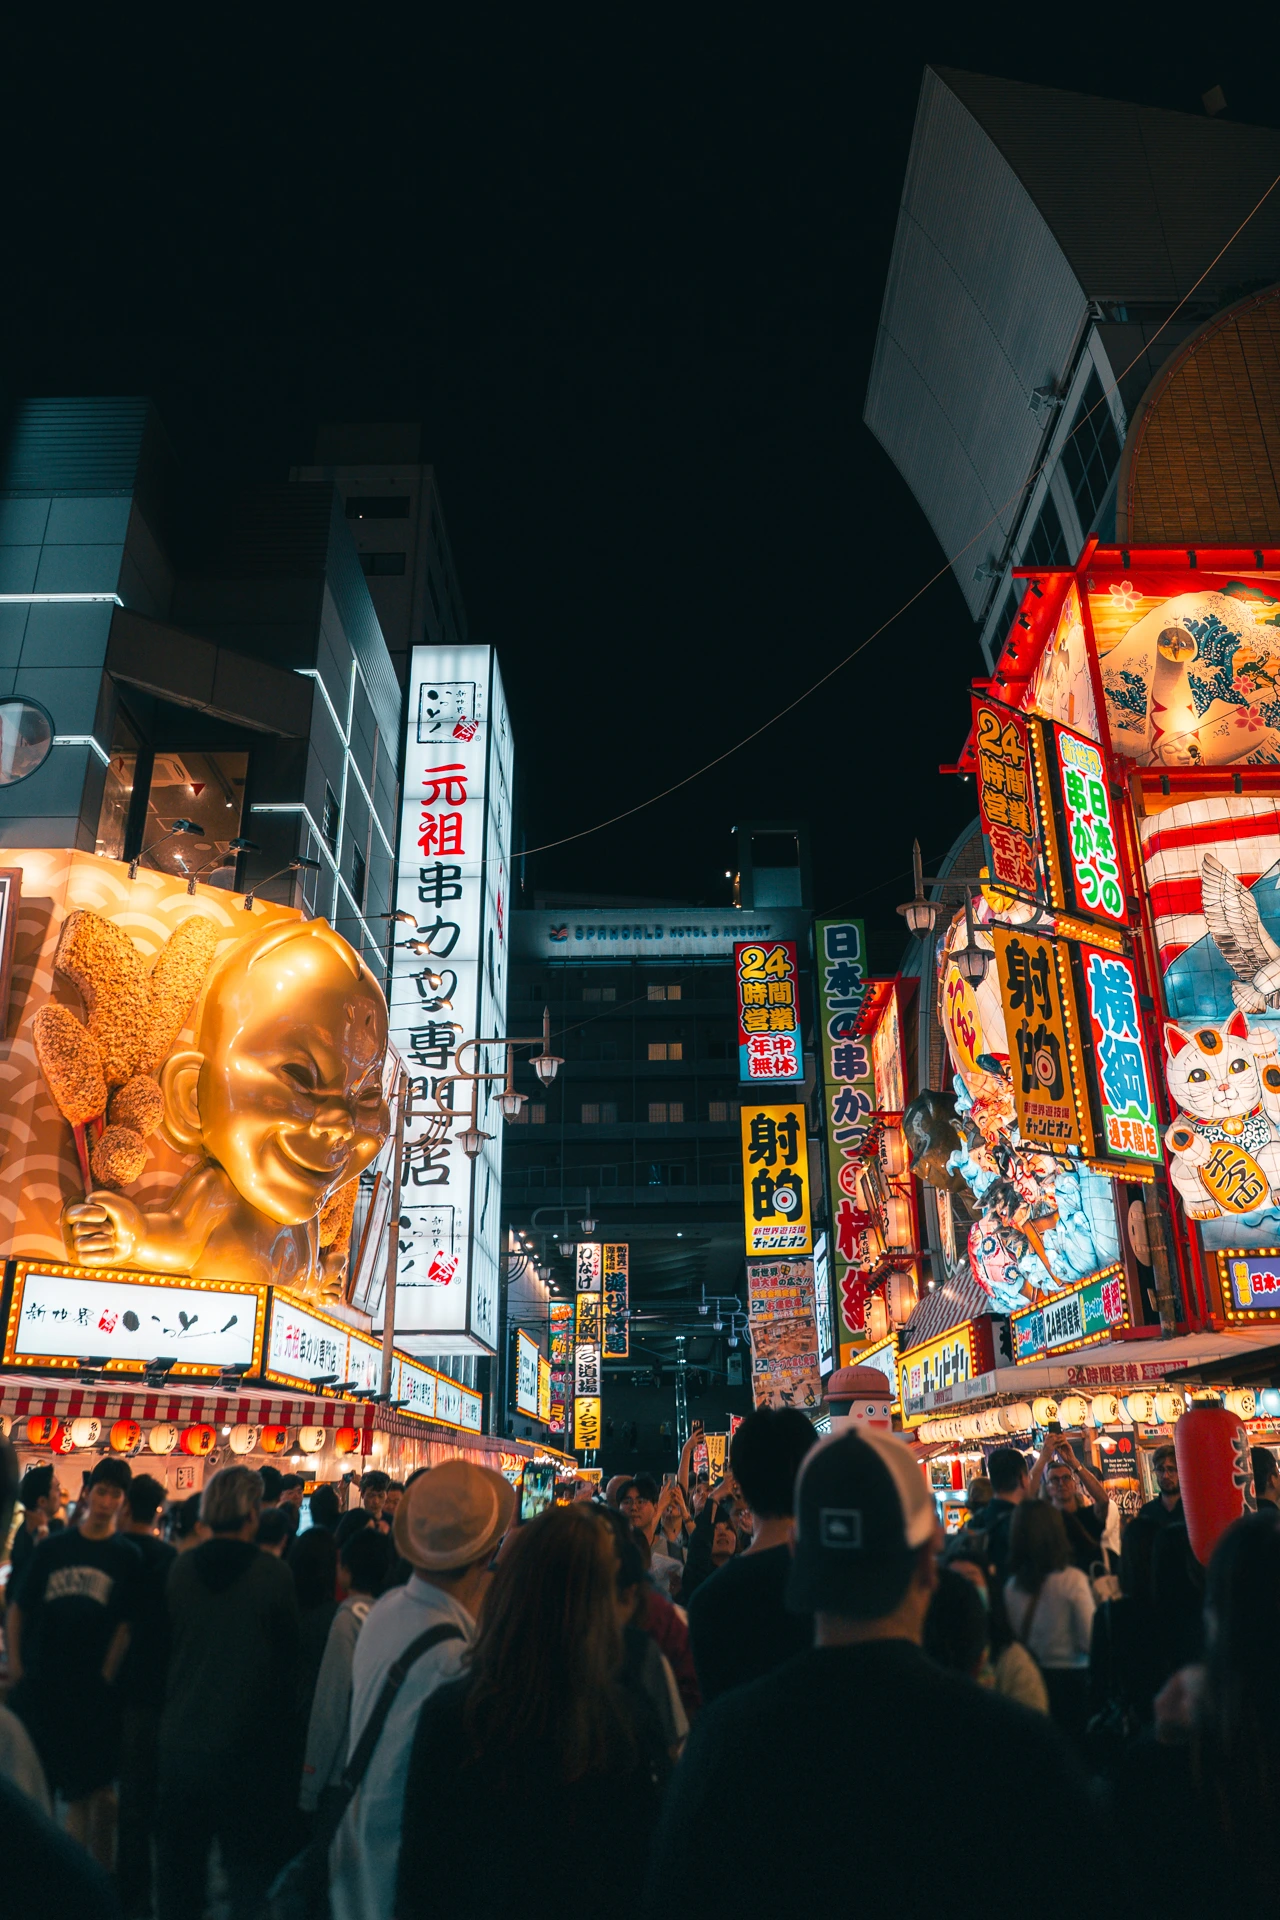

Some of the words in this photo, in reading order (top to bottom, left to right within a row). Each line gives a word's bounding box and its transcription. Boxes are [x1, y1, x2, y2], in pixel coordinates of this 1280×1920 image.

[977, 708, 1026, 766] 24
[1061, 733, 1102, 777] 新世界
[980, 752, 1027, 800] 時間
[982, 787, 1033, 838] 営業
[1064, 769, 1100, 907] 串かつ
[1087, 778, 1122, 916] 日本一の
[739, 945, 792, 979] 24
[742, 981, 793, 1006] 時間
[743, 1007, 796, 1033] 営業
[1005, 939, 1064, 1101] 射的
[1089, 957, 1150, 1117] 横綱
[750, 1035, 795, 1056] 年中
[750, 1056, 798, 1077] 無休
[1023, 1101, 1071, 1120] 新世界遊技場
[1025, 1117, 1073, 1139] チャンピオン
[1109, 1117, 1158, 1156] 通天閣店
[748, 1112, 804, 1222] 射的
[753, 1226, 807, 1237] 新世界遊技場
[753, 1236, 808, 1249] チャンピオン
[579, 1246, 594, 1289] わなげ
[751, 1267, 779, 1278] 新世界
[1251, 1273, 1280, 1293] 日本
[1045, 1300, 1081, 1343] 24時間営業
[1067, 1363, 1140, 1385] 24時間営業
[579, 1400, 598, 1447] ゲームセンター
